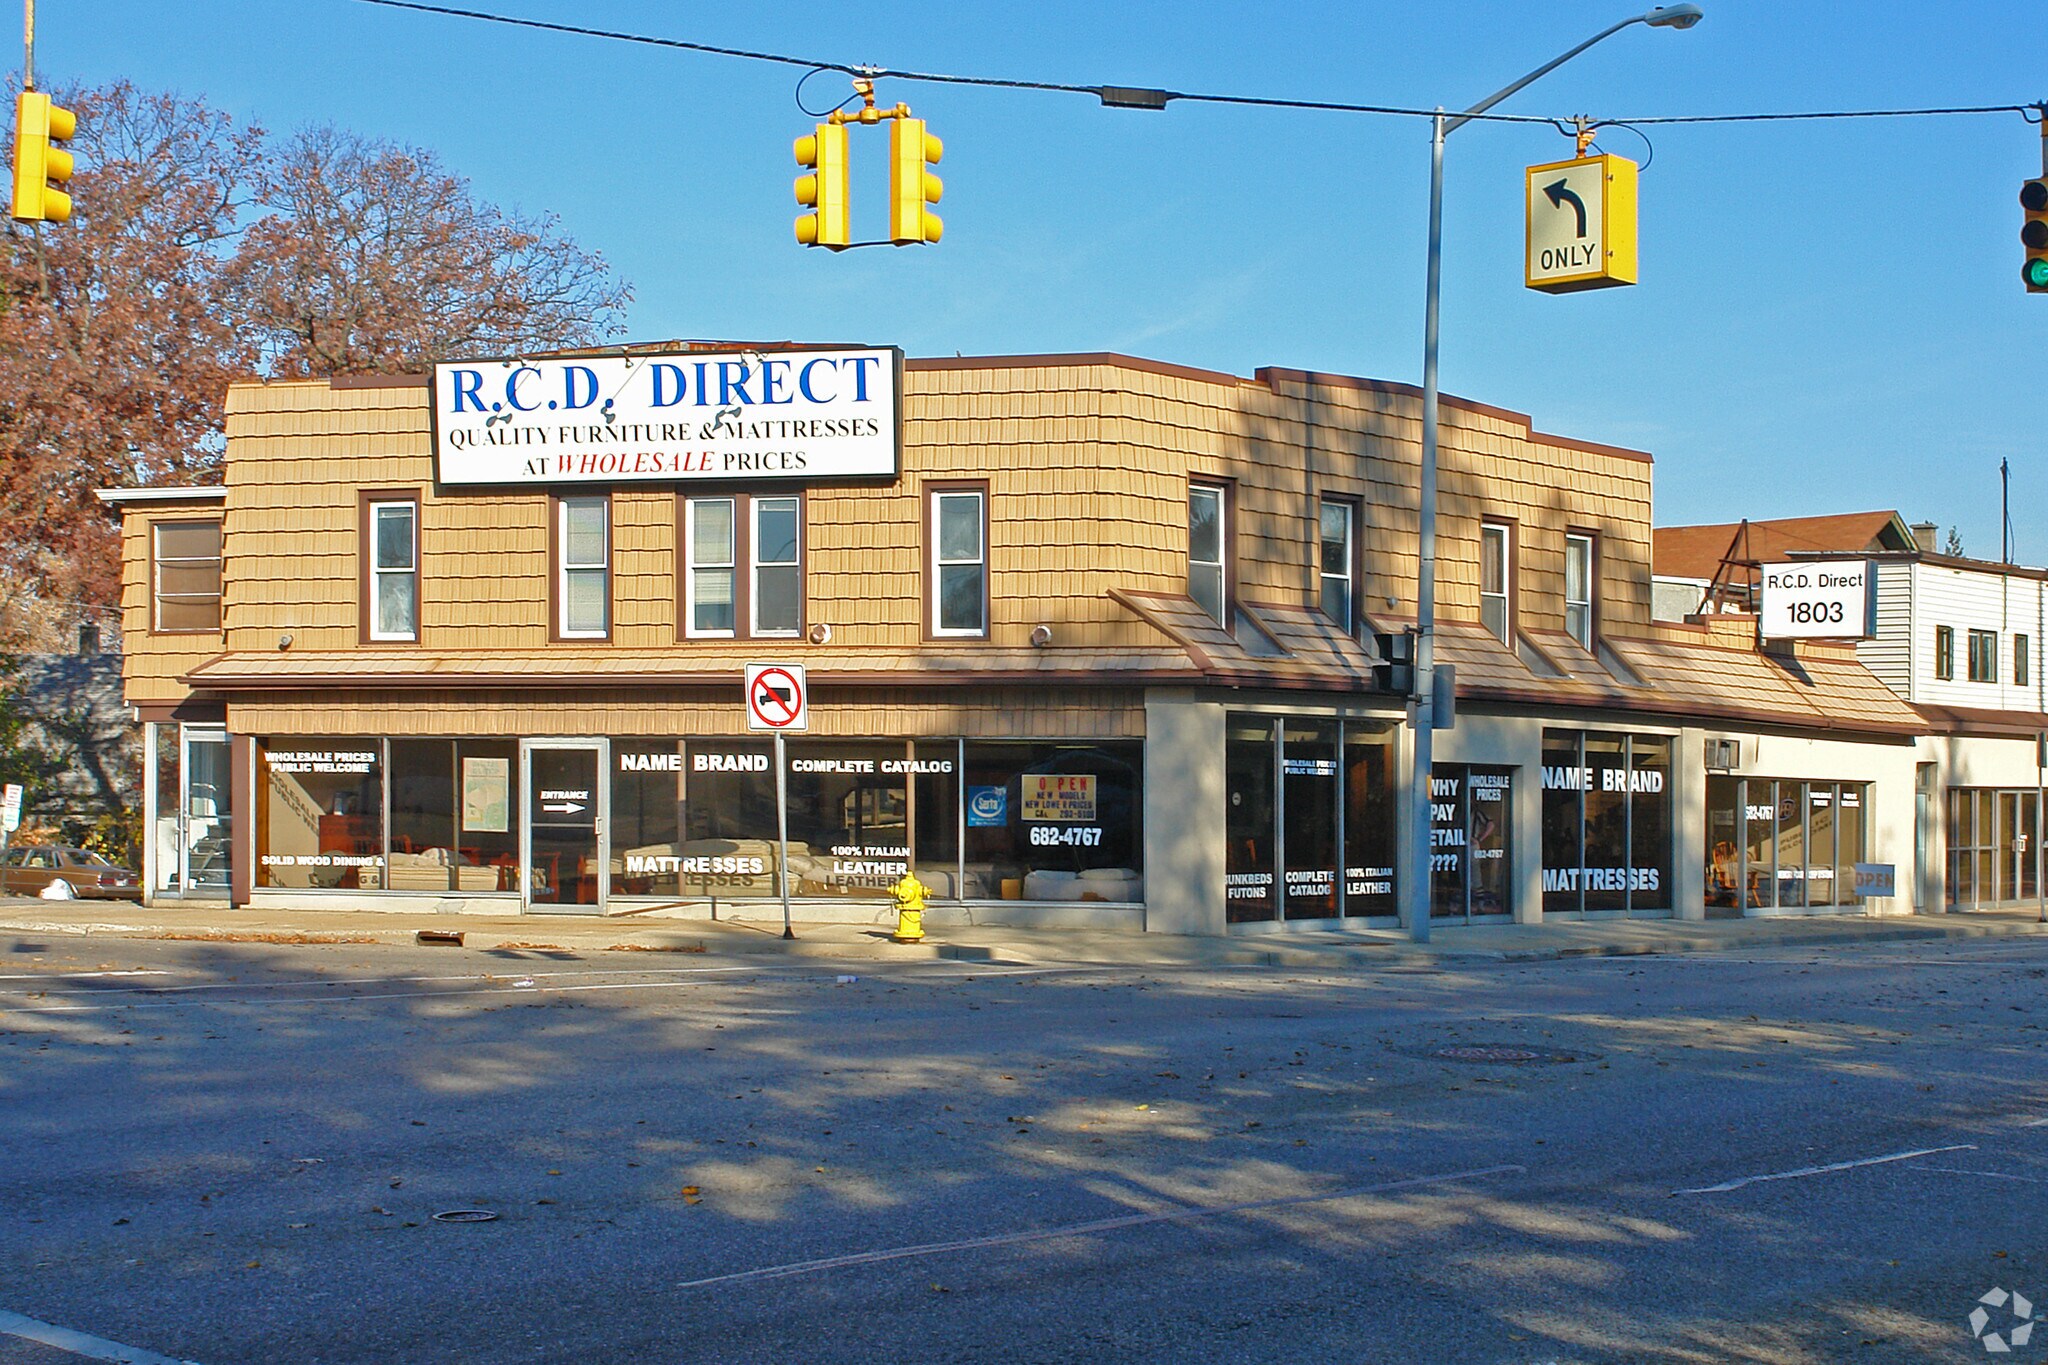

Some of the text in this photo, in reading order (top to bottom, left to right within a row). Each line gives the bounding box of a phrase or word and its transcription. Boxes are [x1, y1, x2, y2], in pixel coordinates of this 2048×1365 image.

[1541, 244, 1595, 270] ONLY
[450, 357, 880, 413] R.C.D. DIRECT
[449, 418, 879, 450] QUALITY FURNITURE & MATTRESSES
[522, 451, 807, 475] AT WHOLESALE PRICES
[1768, 573, 1863, 588] R.C.D. Direct
[1787, 601, 1844, 623] 1803
[264, 752, 375, 762] WHOLESALE PRICES
[621, 755, 769, 772] NAME BRAND
[271, 763, 370, 773] PUBLIC WELCOME
[792, 760, 953, 773] COMPLETE CATALOG
[1039, 777, 1088, 791] OPEN
[1470, 775, 1510, 788] WHOLESALE
[1542, 766, 1663, 793] NAME BRAND
[1432, 779, 1459, 796] WHY
[1476, 788, 1502, 801] PRICES
[541, 791, 589, 799] ENTRANCE
[1025, 801, 1040, 809] NEW
[1431, 804, 1455, 821] PAY
[1030, 827, 1102, 846] 682-4767
[831, 846, 911, 857] 100% ITALIAN
[261, 856, 386, 867] SOLID WOOD DINING &
[626, 856, 764, 874] MATTRESSES
[833, 861, 908, 875] LEATHER
[1285, 871, 1335, 883] COMPLETE
[1366, 867, 1393, 876] ITALIAN
[1542, 868, 1660, 892] MATTRESSES
[1856, 872, 1894, 887] OPEN
[1228, 887, 1266, 899] FUTONS
[1289, 885, 1331, 896] CATALOG
[1347, 882, 1391, 895] LEATHER
